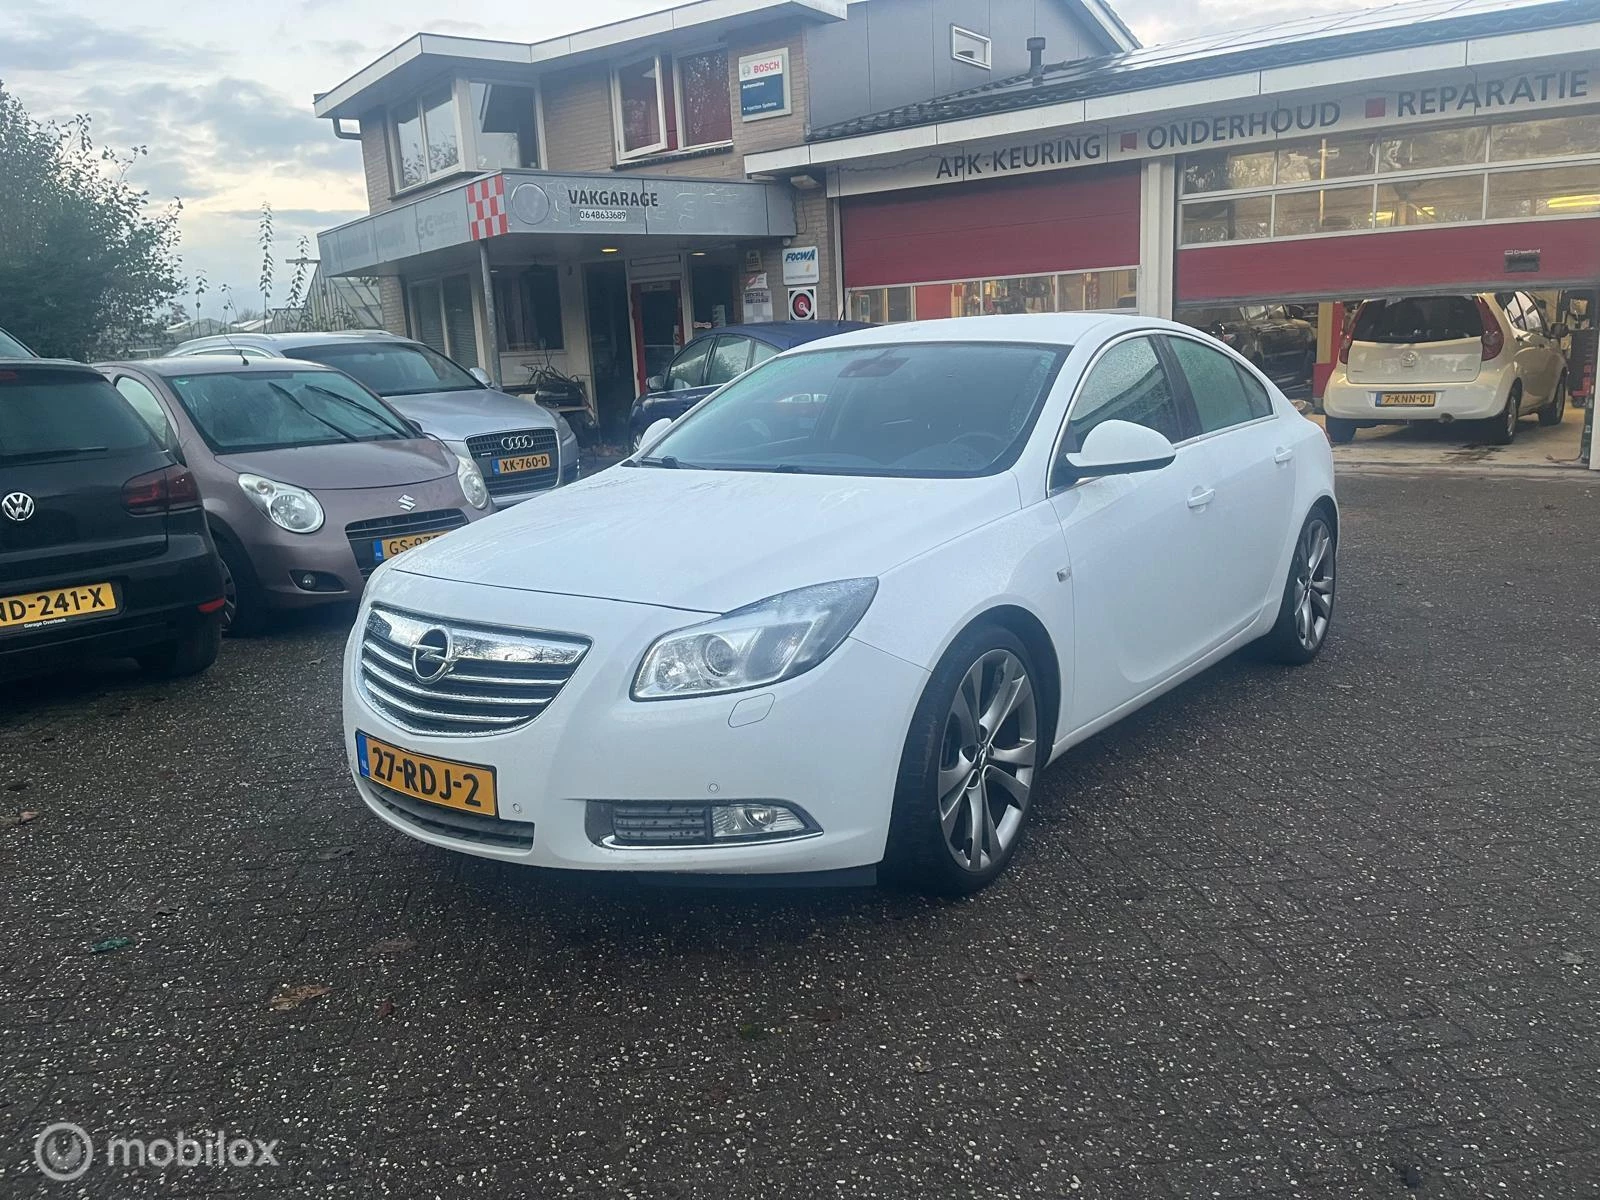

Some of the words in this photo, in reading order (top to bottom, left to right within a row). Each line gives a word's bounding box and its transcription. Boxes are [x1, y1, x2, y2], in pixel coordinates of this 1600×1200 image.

[753, 61, 780, 74] BOSCH
[1147, 102, 1341, 150] ONDERHOUD
[1397, 69, 1589, 117] REPARATIE
[568, 189, 658, 207] VAKGARAGE
[785, 249, 816, 262] FOCWA
[1385, 395, 1431, 404] 7-KNN-01
[502, 456, 548, 472] XK-760-D
[373, 746, 481, 807] 27-RDJ-2
